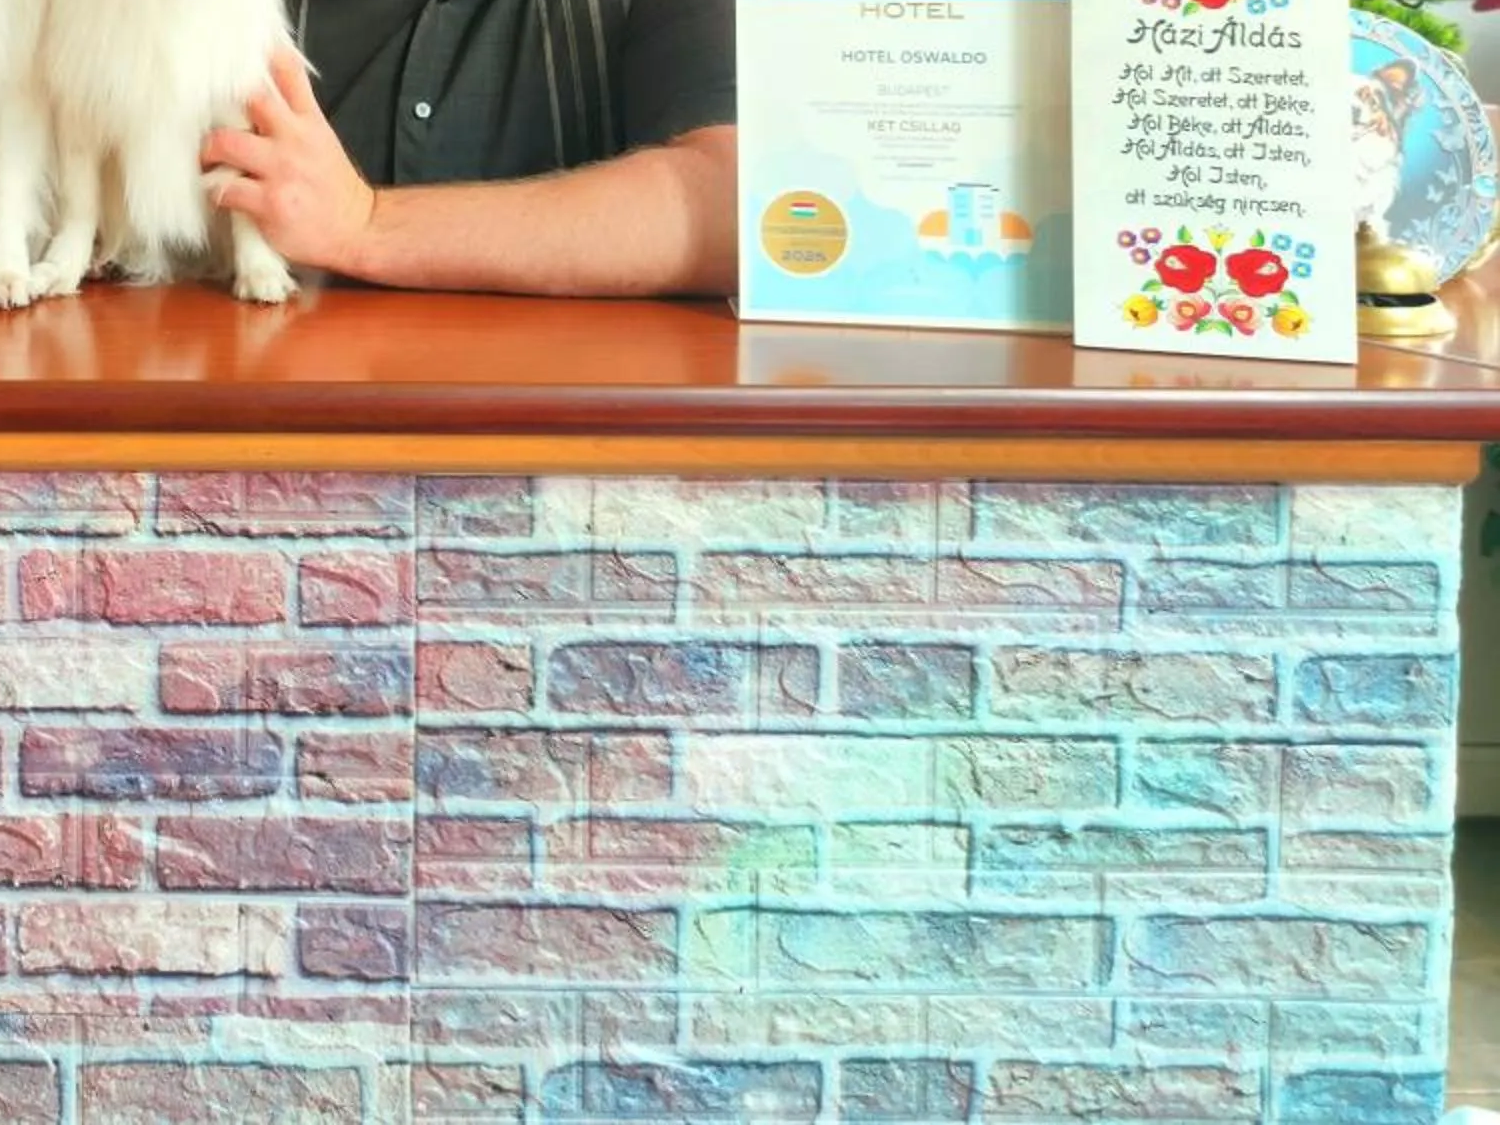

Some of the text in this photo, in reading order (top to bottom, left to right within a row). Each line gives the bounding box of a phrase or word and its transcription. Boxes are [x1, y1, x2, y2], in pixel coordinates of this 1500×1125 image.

[859, 1, 965, 20] HOTEL
[1125, 15, 1303, 55] Házi Áldás
[840, 49, 988, 65] HOTEL OSWALDO
[1118, 62, 1154, 86] Hol
[1200, 66, 1222, 83] ott
[1111, 87, 1147, 110] Hol
[1236, 92, 1258, 110] ott
[1126, 112, 1162, 136] Hol
[1220, 118, 1243, 135] ott
[1120, 137, 1155, 161] Hol
[1223, 142, 1246, 160] ott
[1165, 163, 1202, 188] Hol
[1124, 188, 1146, 206] ott
